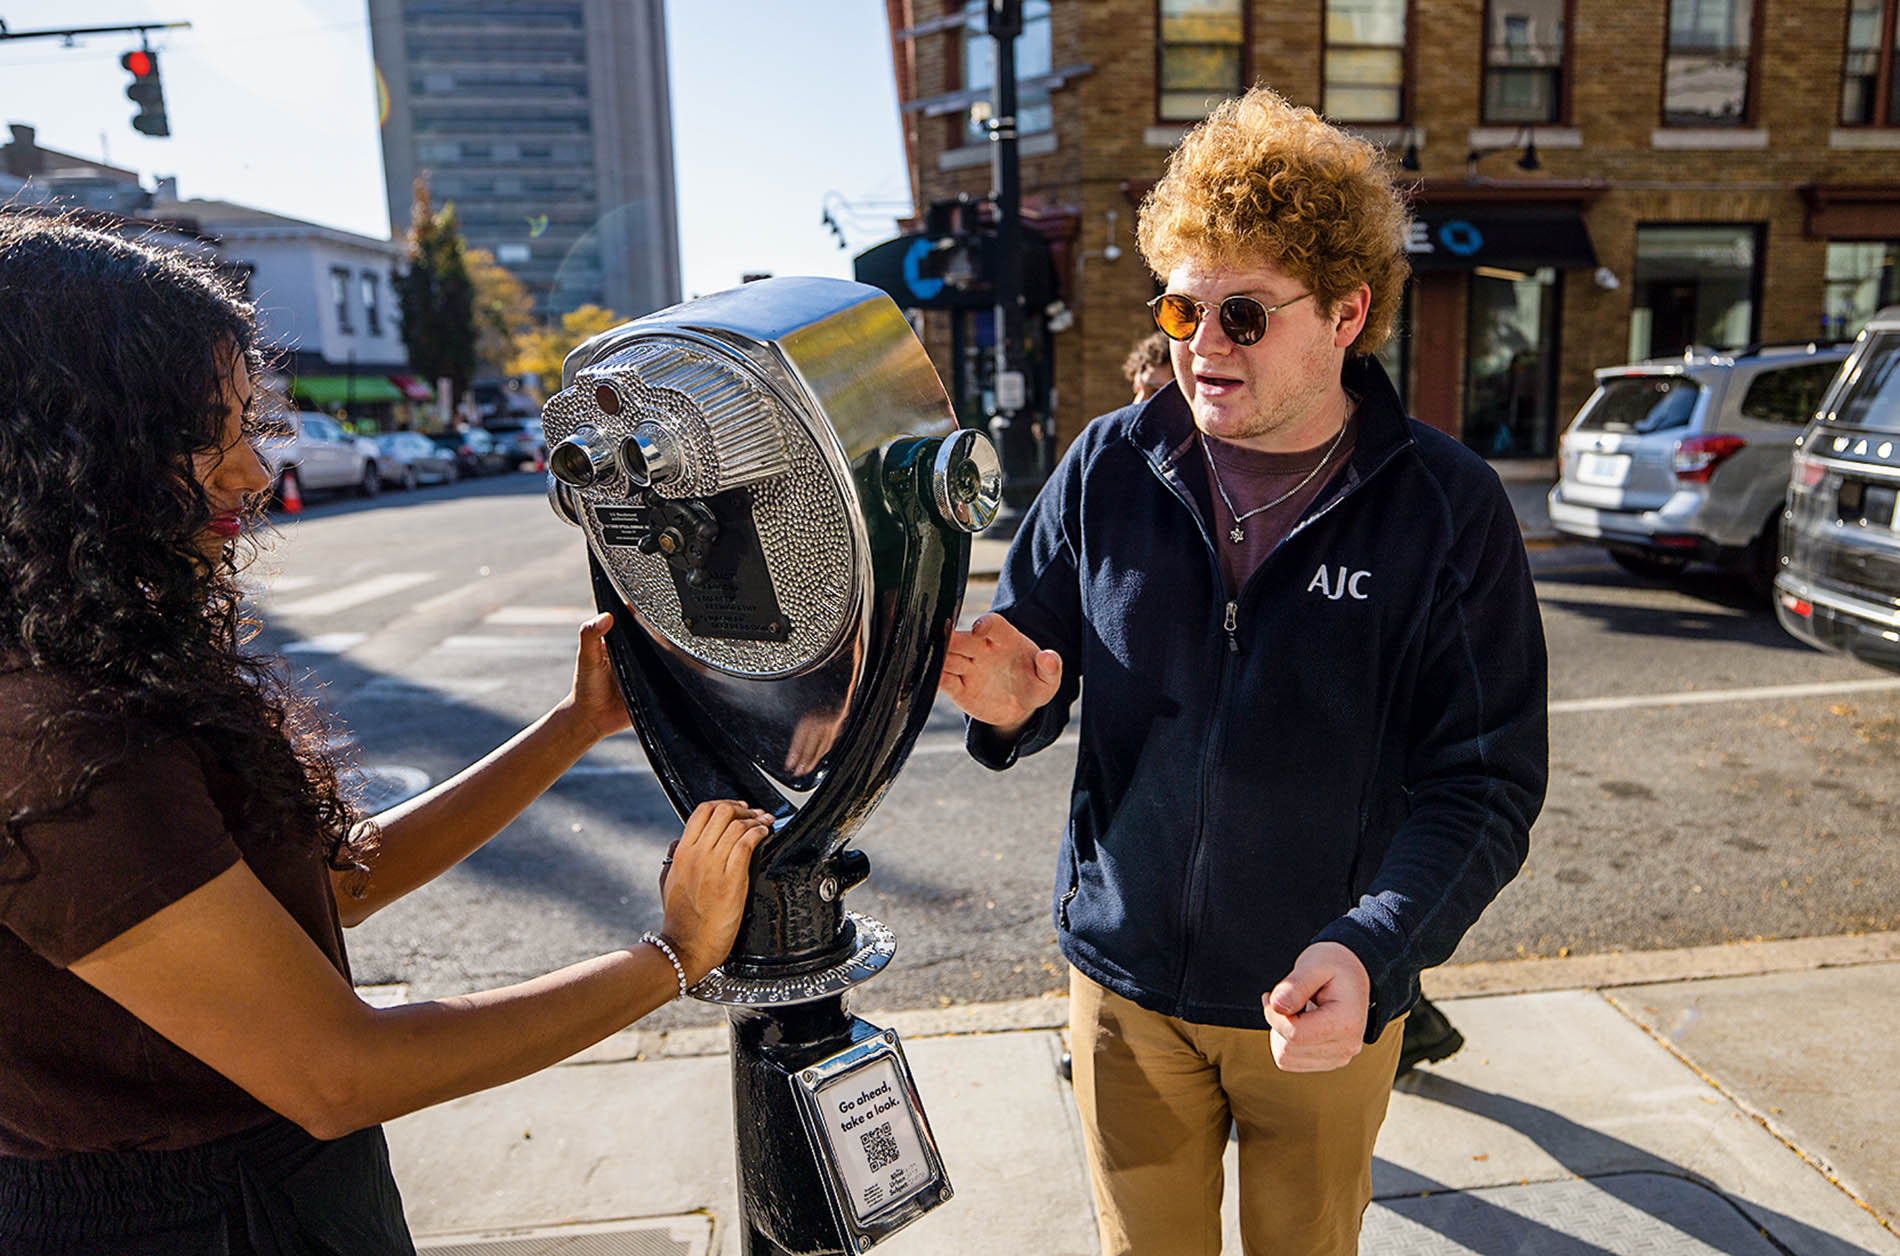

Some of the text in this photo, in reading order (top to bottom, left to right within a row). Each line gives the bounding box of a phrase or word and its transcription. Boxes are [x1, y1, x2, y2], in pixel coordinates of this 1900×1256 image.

[1307, 563, 1372, 600] AJC
[838, 1080, 891, 1114] Go ahead,
[841, 1096, 900, 1132] take a look.
